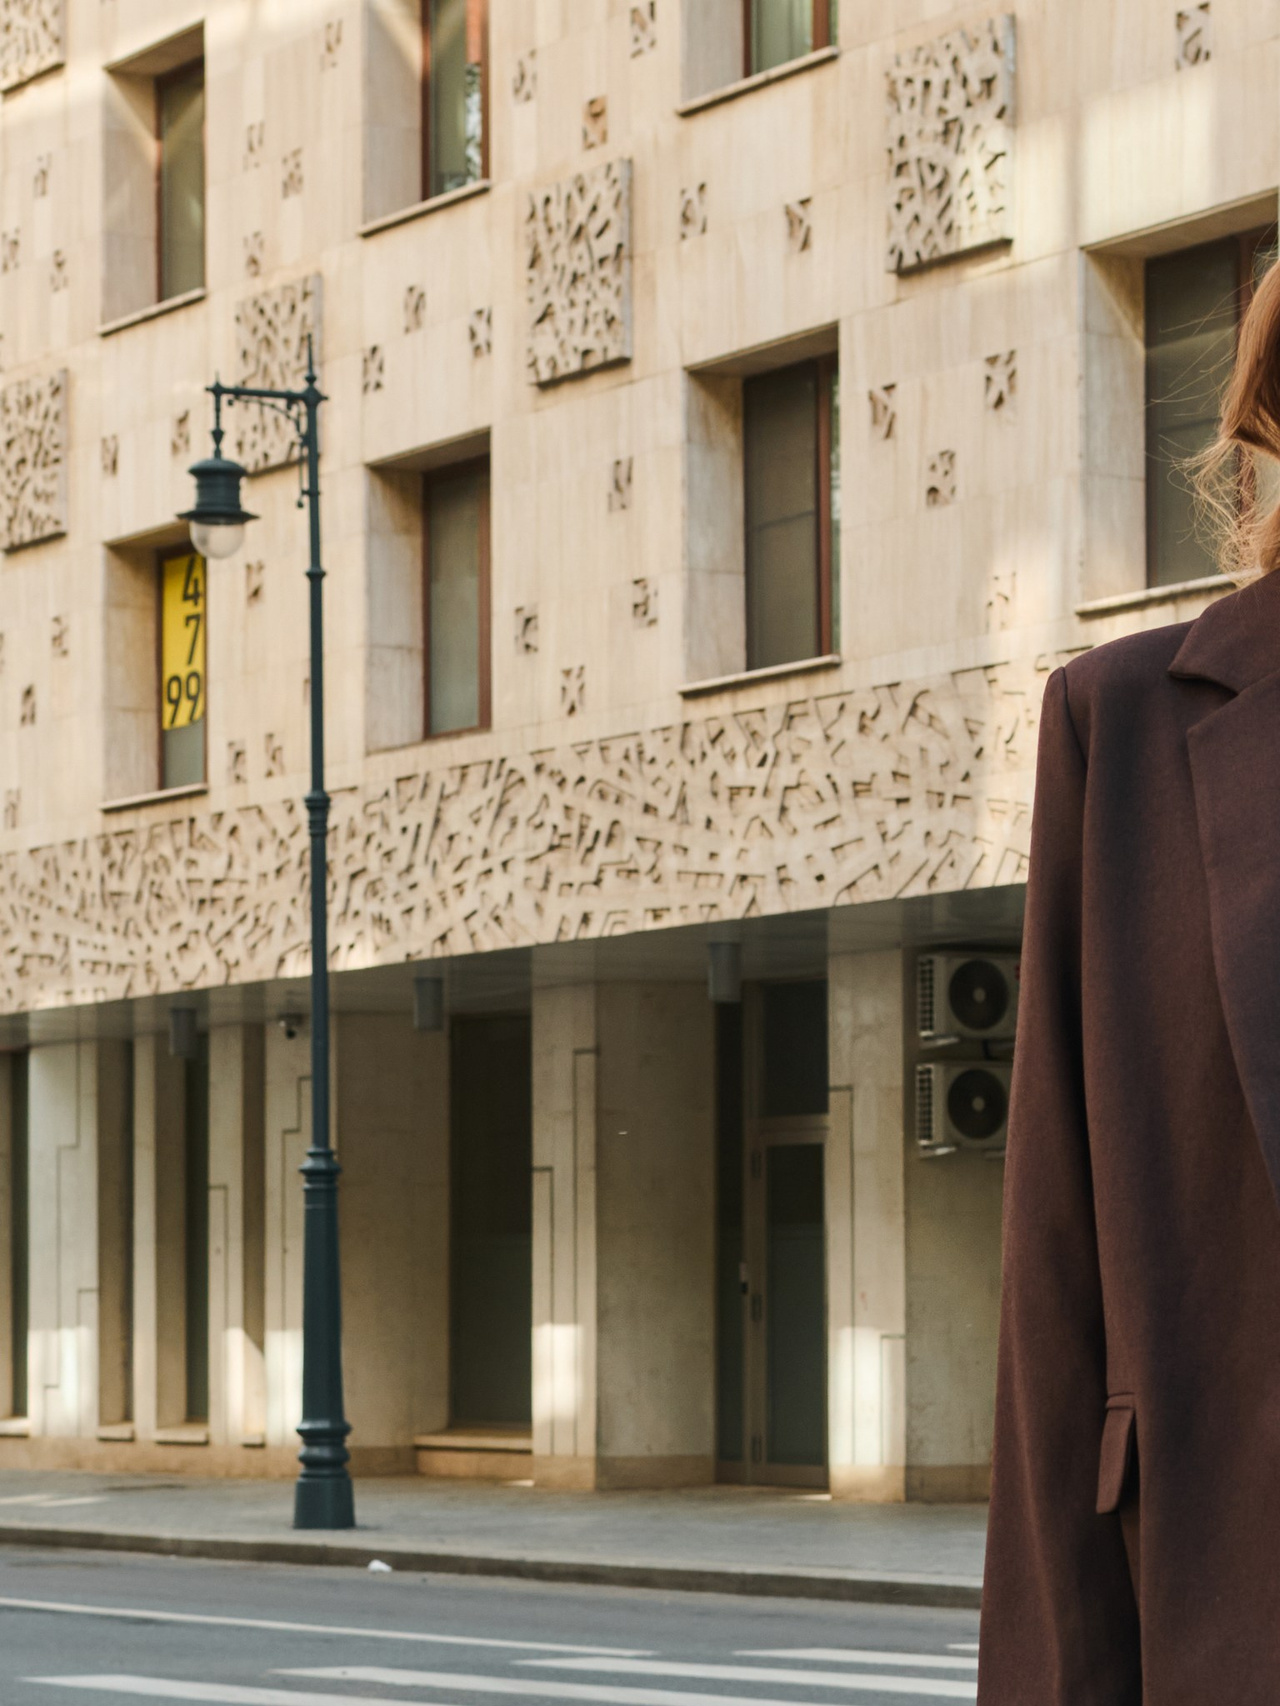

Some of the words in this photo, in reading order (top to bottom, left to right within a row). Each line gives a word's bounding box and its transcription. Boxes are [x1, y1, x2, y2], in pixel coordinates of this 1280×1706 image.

[182, 555, 201, 606] 4
[185, 613, 201, 665] 7
[167, 671, 201, 724] 99
